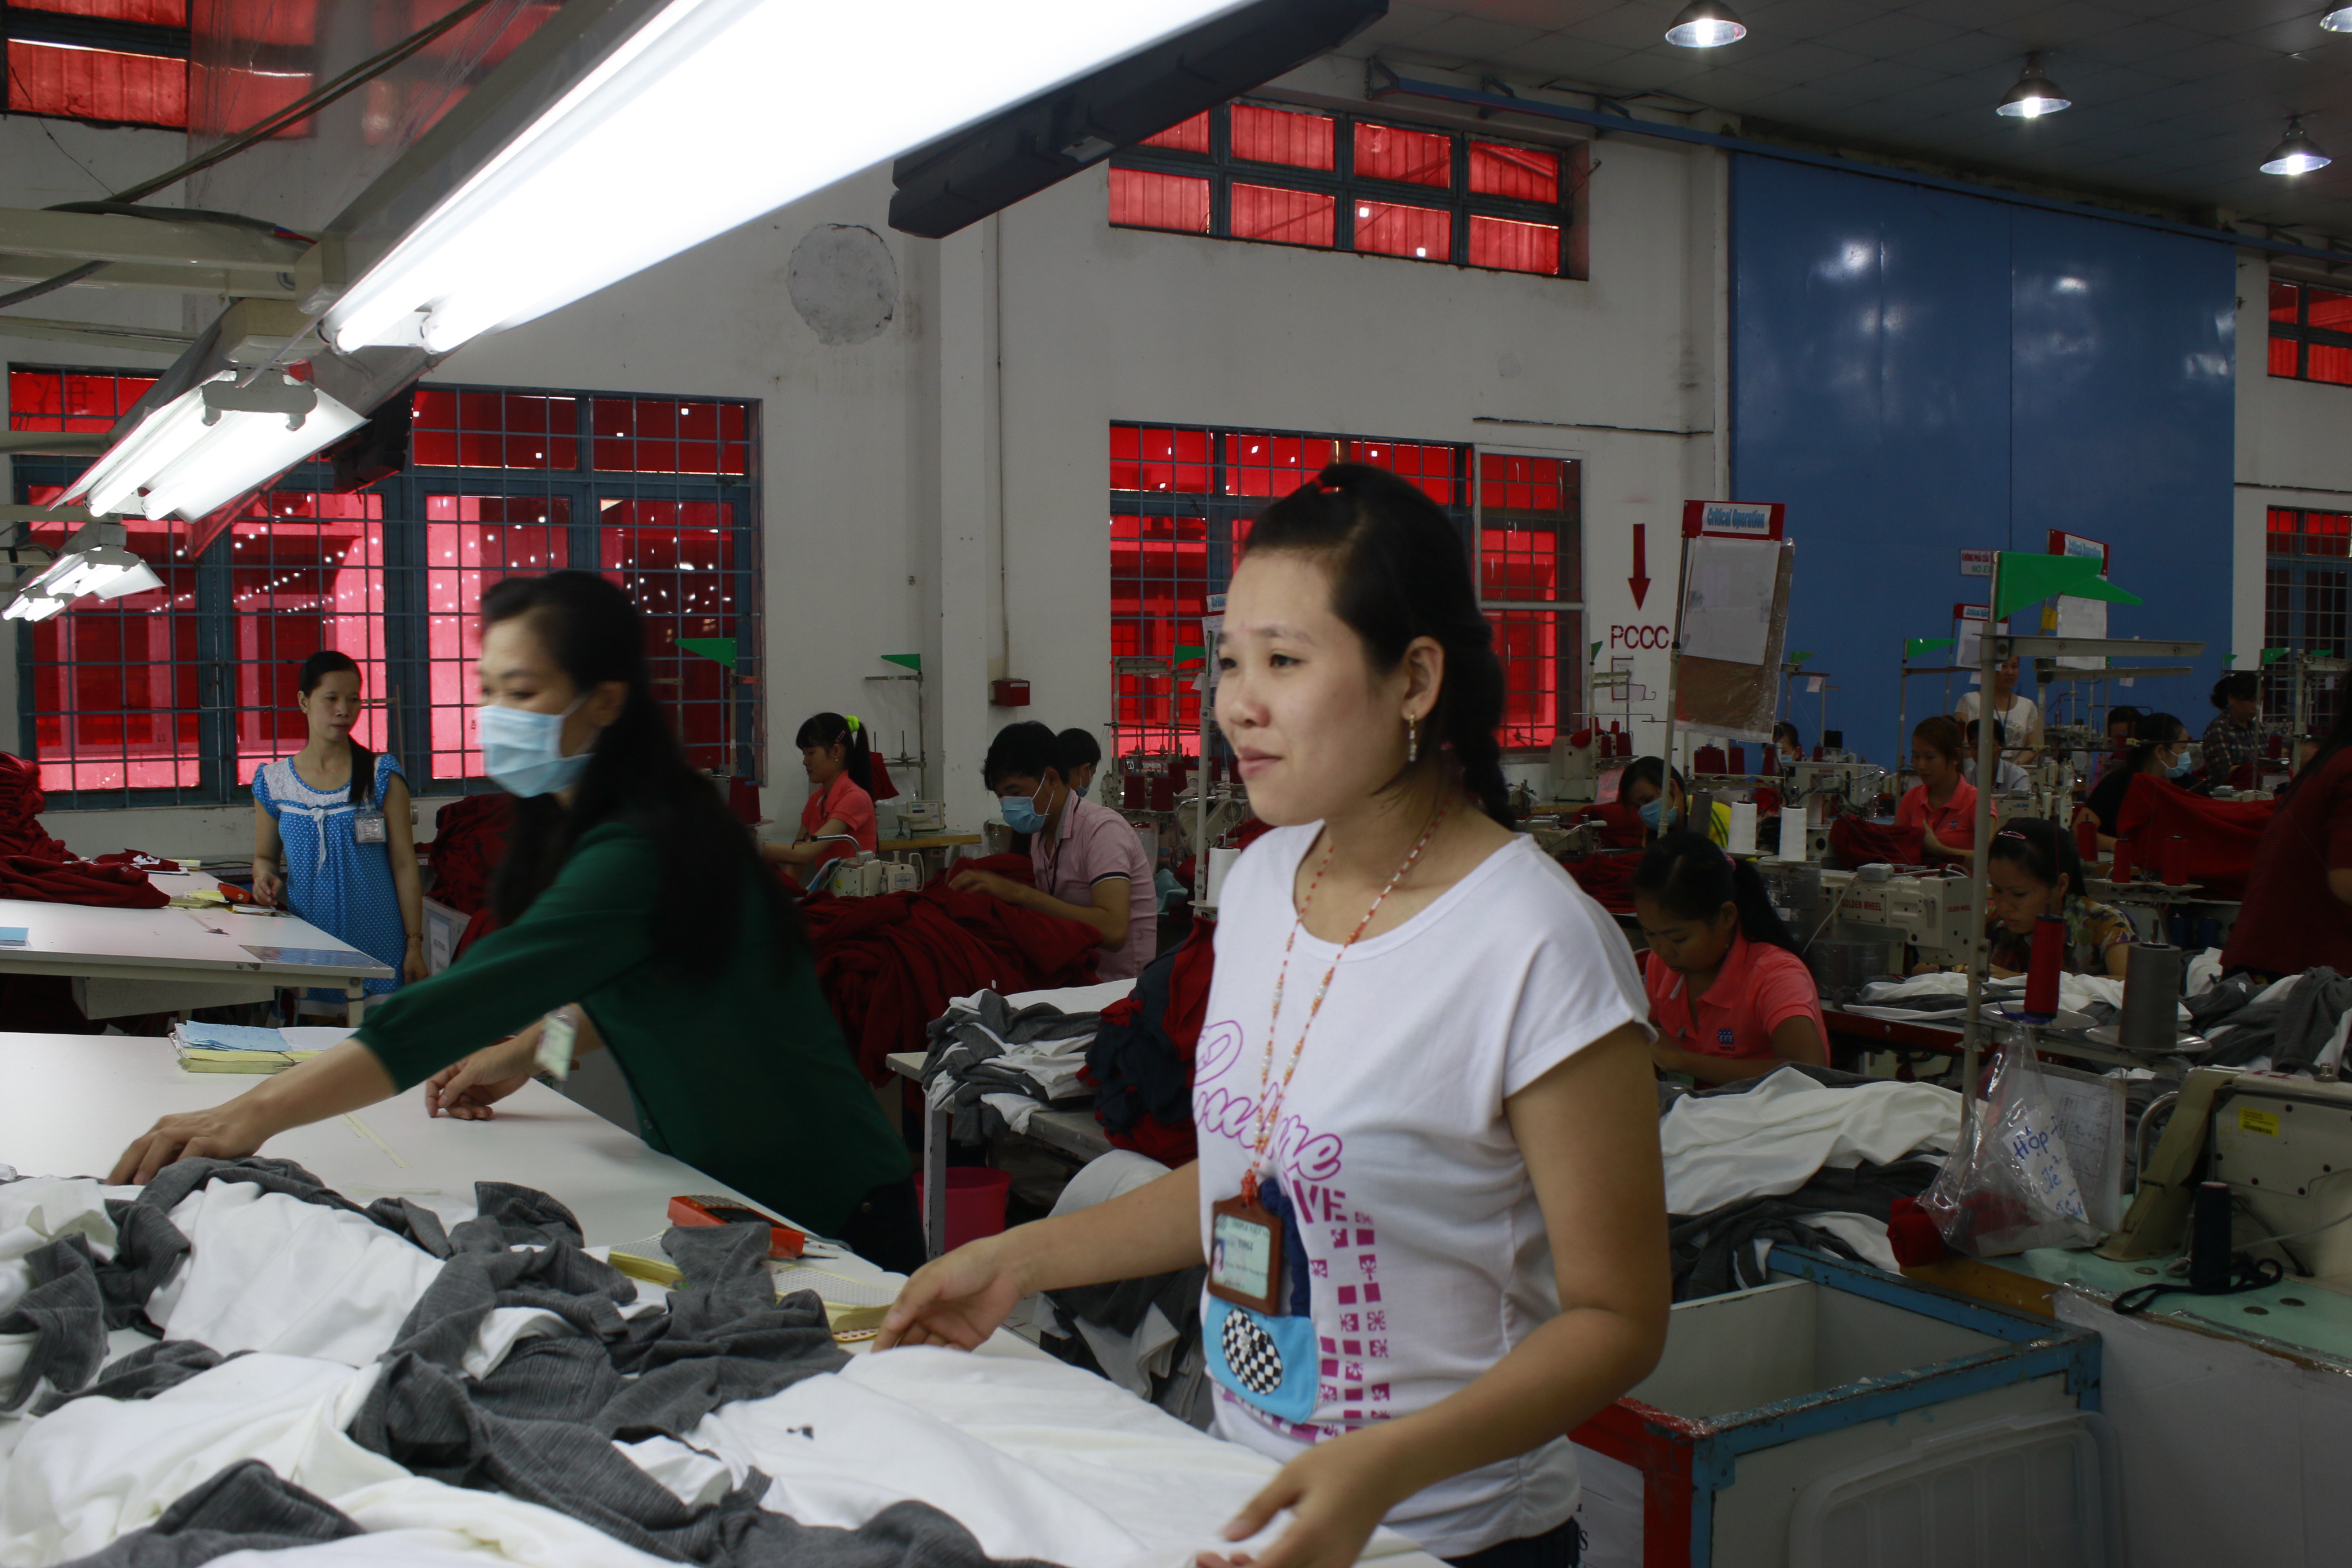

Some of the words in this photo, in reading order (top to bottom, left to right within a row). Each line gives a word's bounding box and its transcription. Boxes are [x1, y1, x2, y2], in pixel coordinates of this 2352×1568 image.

[1707, 507, 1732, 527] Critical
[1732, 508, 1765, 529] Operation
[1611, 625, 1669, 649] PCCC
[1841, 899, 1862, 909] GOLDEN
[1864, 901, 1882, 912] WHEEL
